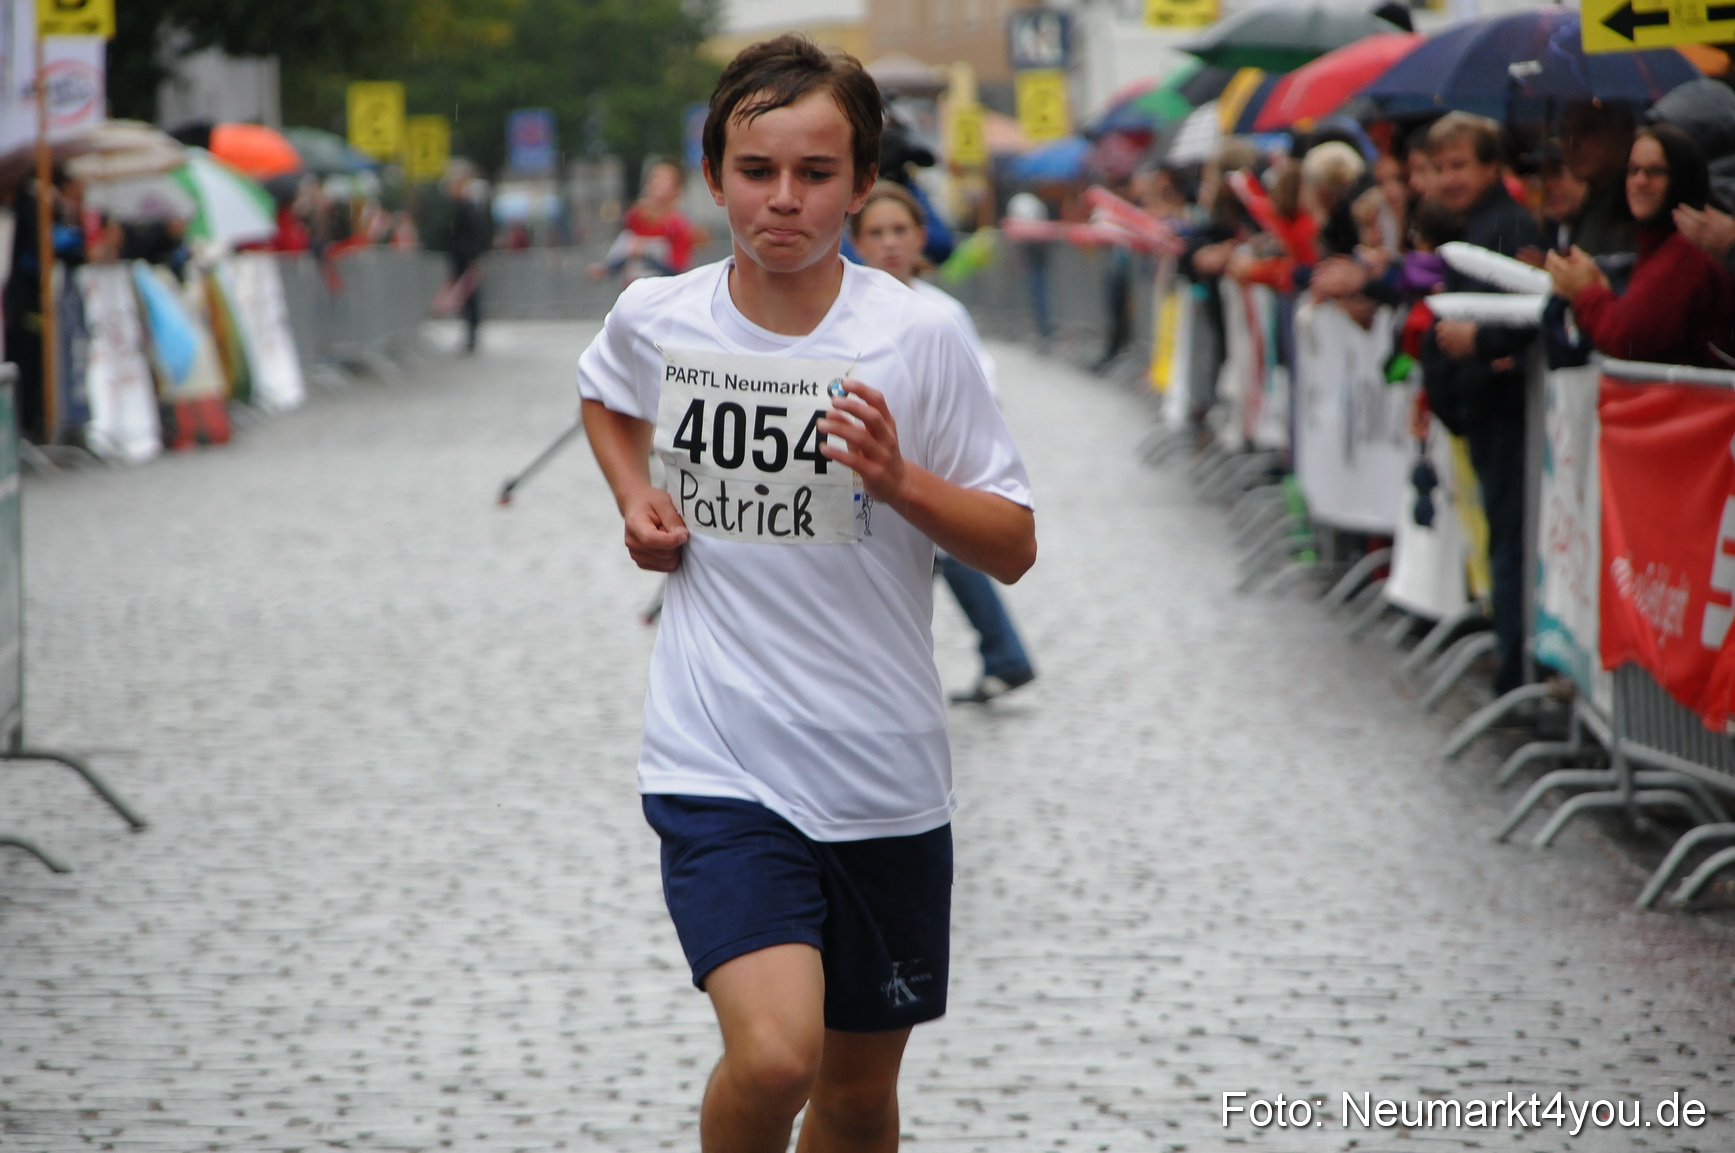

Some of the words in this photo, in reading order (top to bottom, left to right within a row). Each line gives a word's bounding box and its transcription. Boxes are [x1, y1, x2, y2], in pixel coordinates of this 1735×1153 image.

[665, 365, 720, 388] PARTL
[724, 374, 819, 396] Neumarkt
[673, 398, 833, 475] 4054
[680, 469, 816, 537] Patrick
